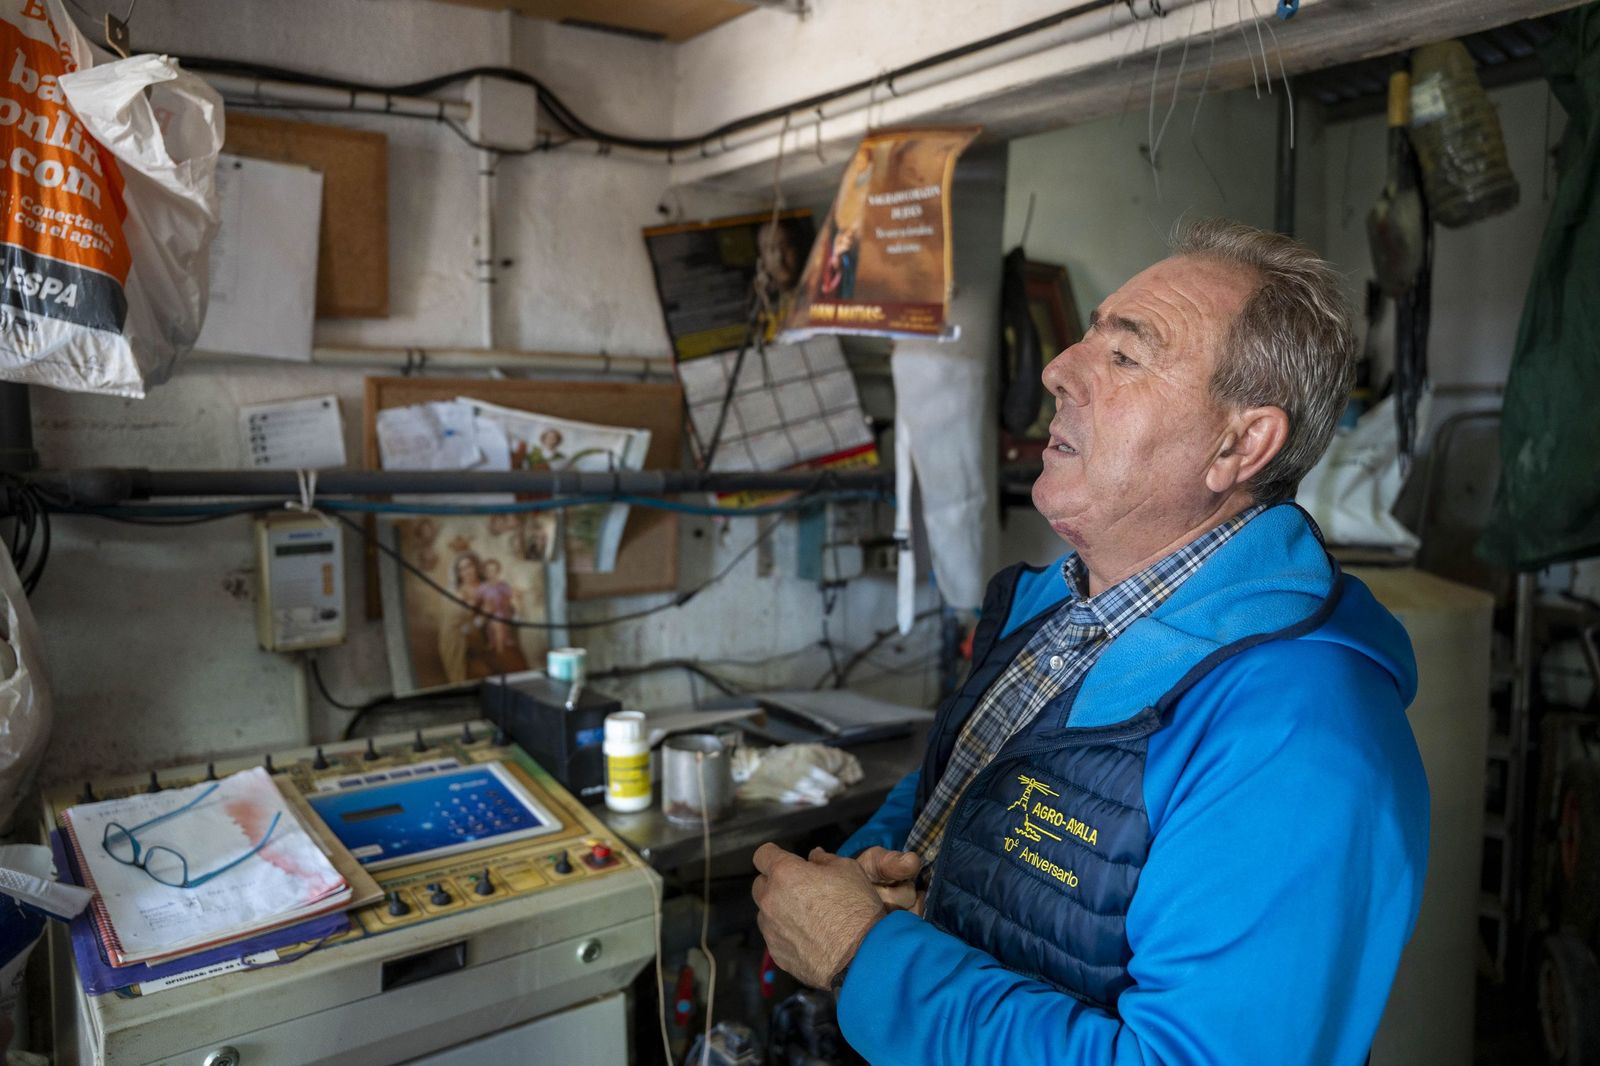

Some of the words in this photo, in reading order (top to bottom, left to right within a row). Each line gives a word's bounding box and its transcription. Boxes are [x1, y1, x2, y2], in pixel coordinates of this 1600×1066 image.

[14, 211, 46, 234] con
[50, 225, 69, 240] el
[1032, 802, 1098, 846] AGRO-AYALA
[1019, 846, 1078, 888] Aniversario
